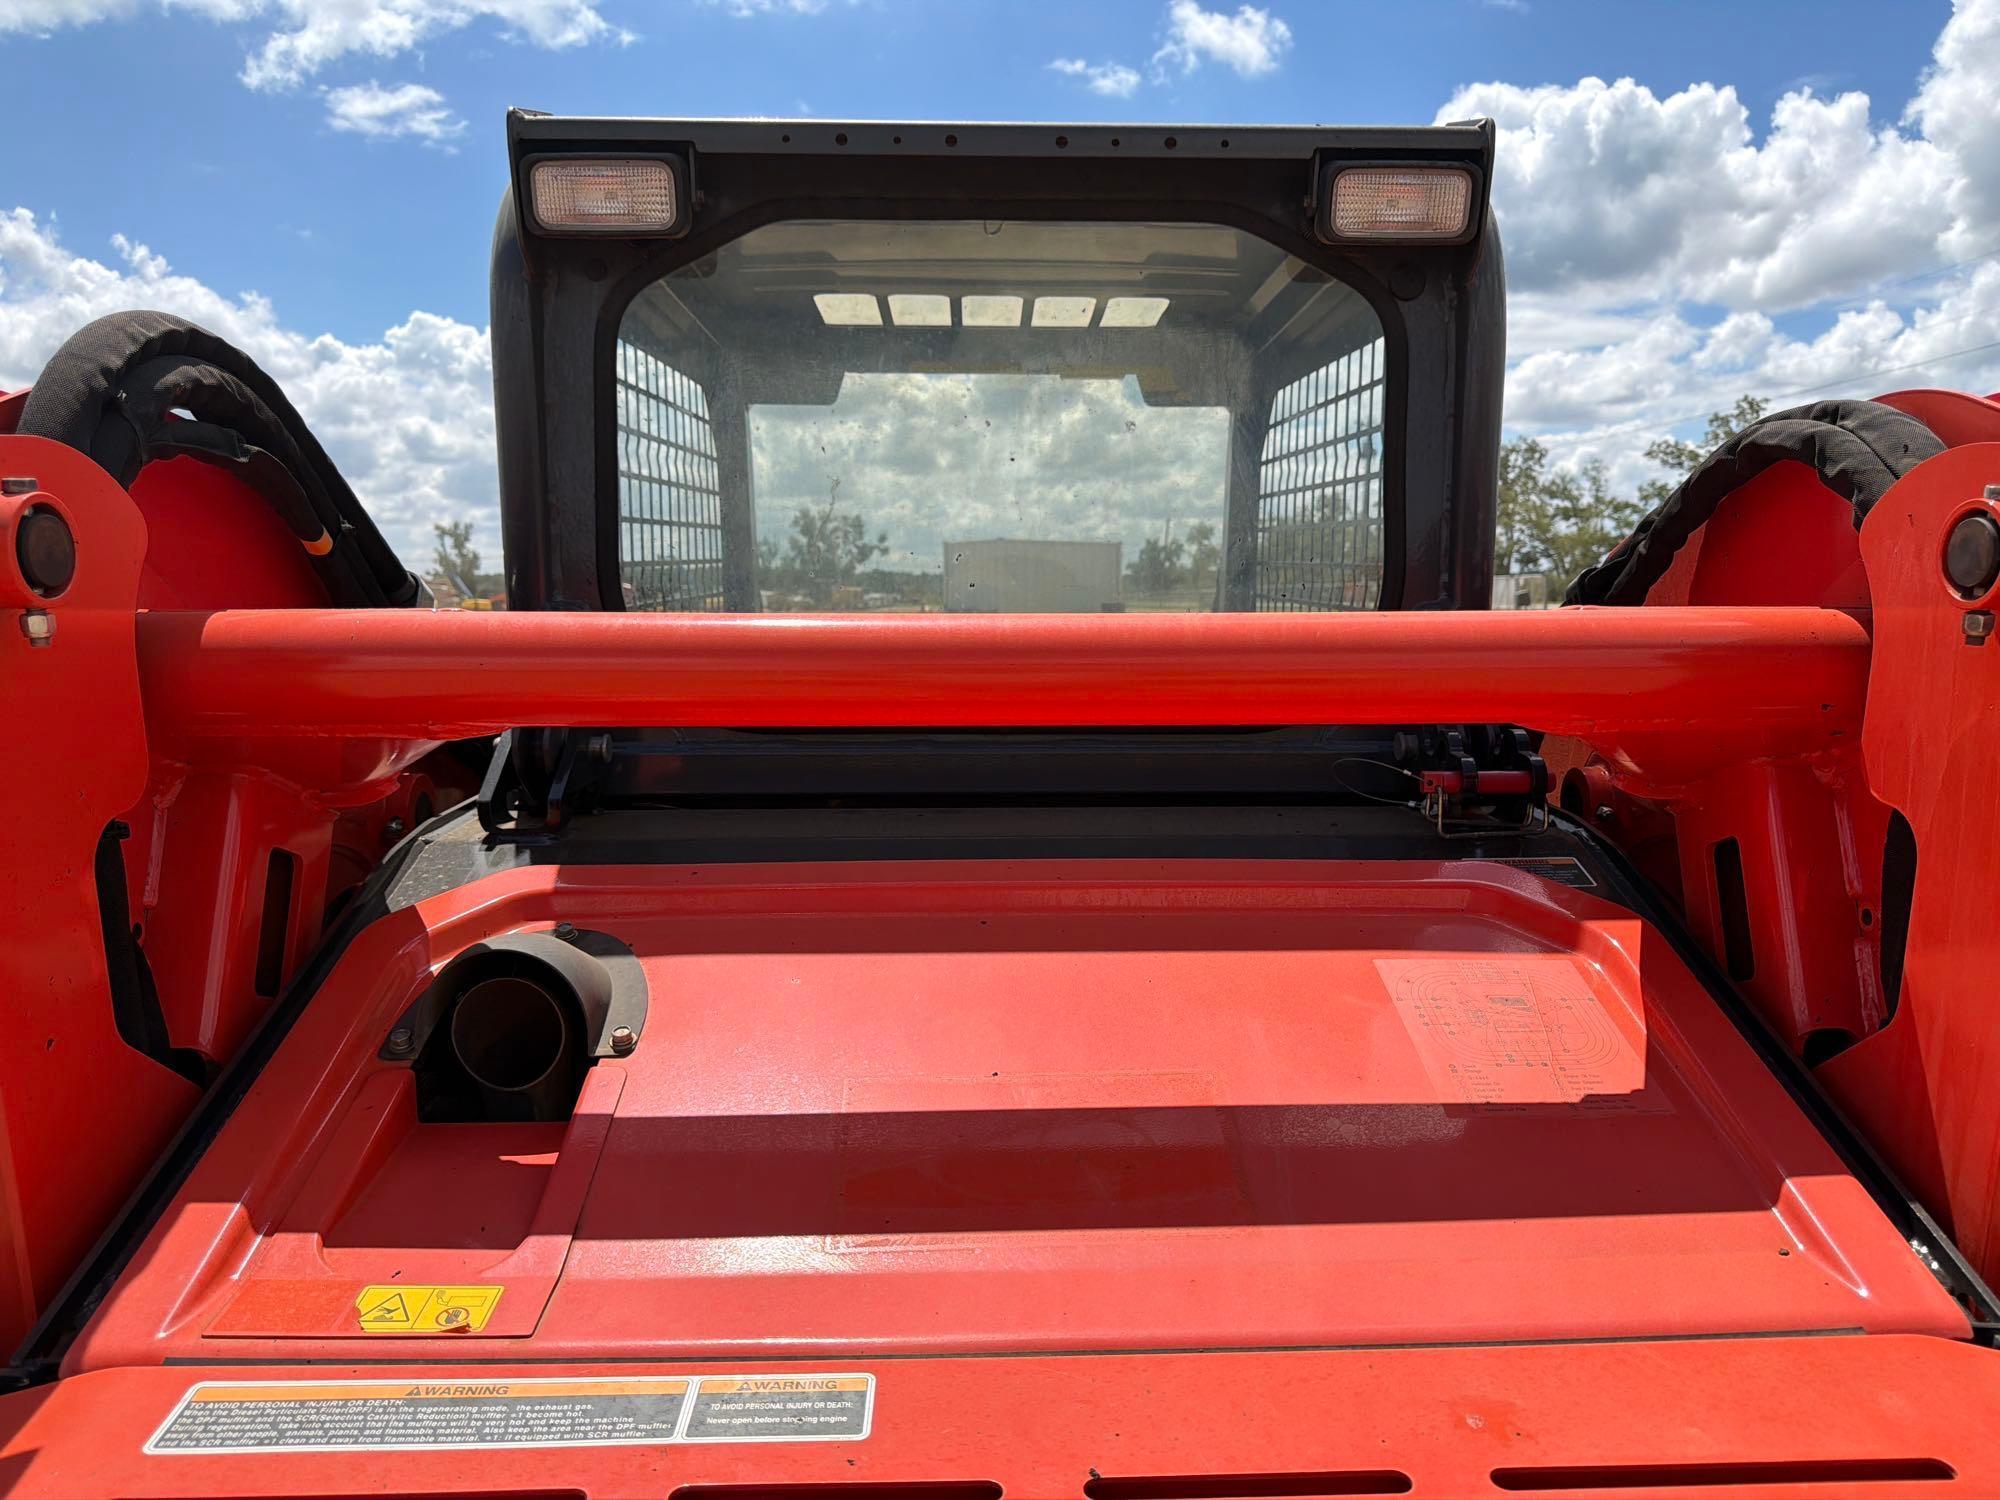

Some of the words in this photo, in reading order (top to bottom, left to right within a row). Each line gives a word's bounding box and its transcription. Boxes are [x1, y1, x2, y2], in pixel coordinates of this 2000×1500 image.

[424, 1385, 510, 1396] WARNING
[754, 1380, 838, 1391] WARNING
[205, 1401, 241, 1409] AVOID
[241, 1401, 301, 1409] PERSONAL
[304, 1400, 346, 1408] INJURY
[366, 1399, 407, 1407] DEATH:
[710, 1403, 721, 1411] TO
[744, 1402, 785, 1410] PERSONAL
[786, 1401, 813, 1409] INJURY
[813, 1401, 825, 1409] OR
[826, 1401, 854, 1409] DEATH:
[706, 1417, 731, 1425] Never
[753, 1416, 781, 1424] before
[819, 1415, 848, 1423] engine
[586, 1431, 609, 1439] SCR
